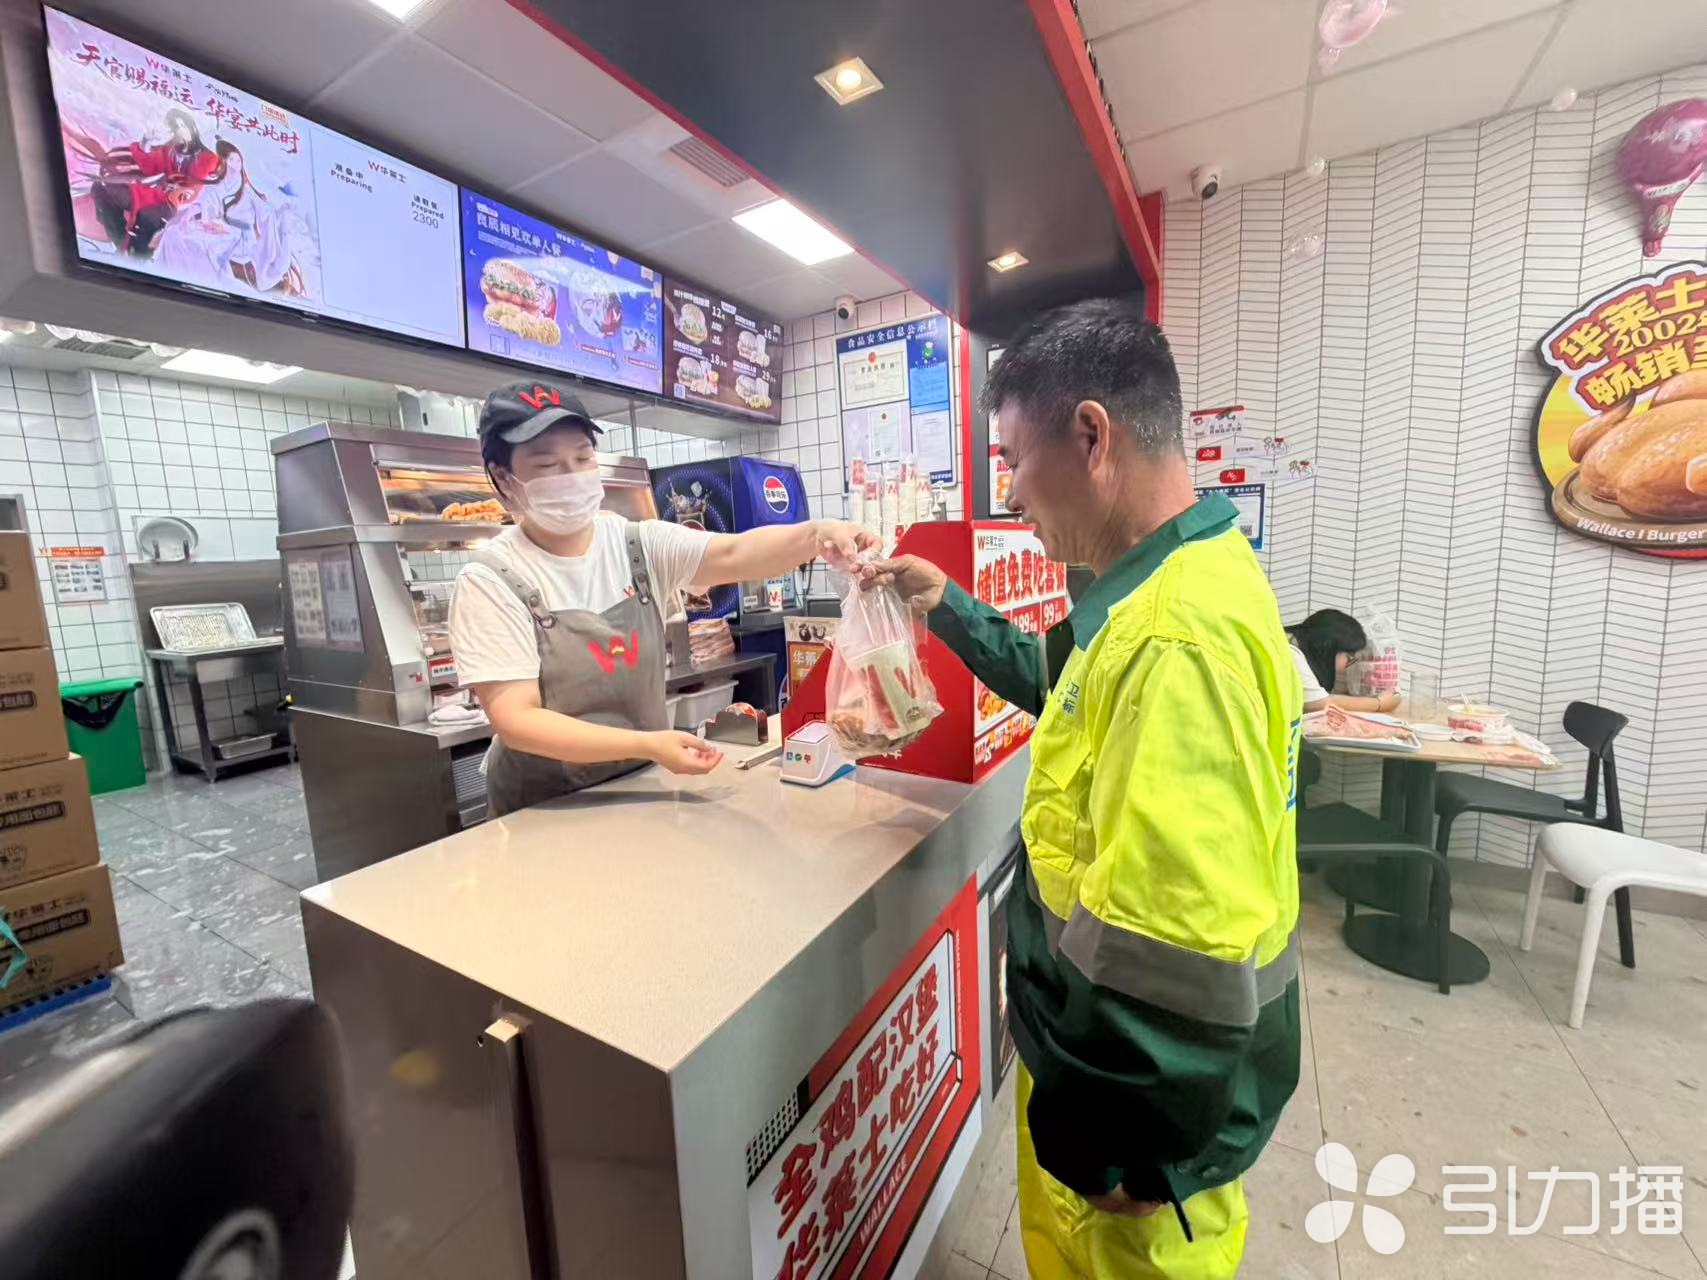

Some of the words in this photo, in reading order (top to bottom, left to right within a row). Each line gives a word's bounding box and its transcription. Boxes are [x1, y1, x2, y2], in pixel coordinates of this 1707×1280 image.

[330, 169, 373, 193] Preparing
[411, 201, 444, 219] Prepared
[412, 211, 439, 229] 2300
[847, 319, 938, 350] 食品安全信息公示栏
[1559, 277, 1707, 365] 华莱士
[1576, 518, 1636, 540] Wallace
[1646, 528, 1707, 543] Burger
[773, 963, 938, 1239] 全鸡配汉堡
[859, 1152, 909, 1245] WALLACE
